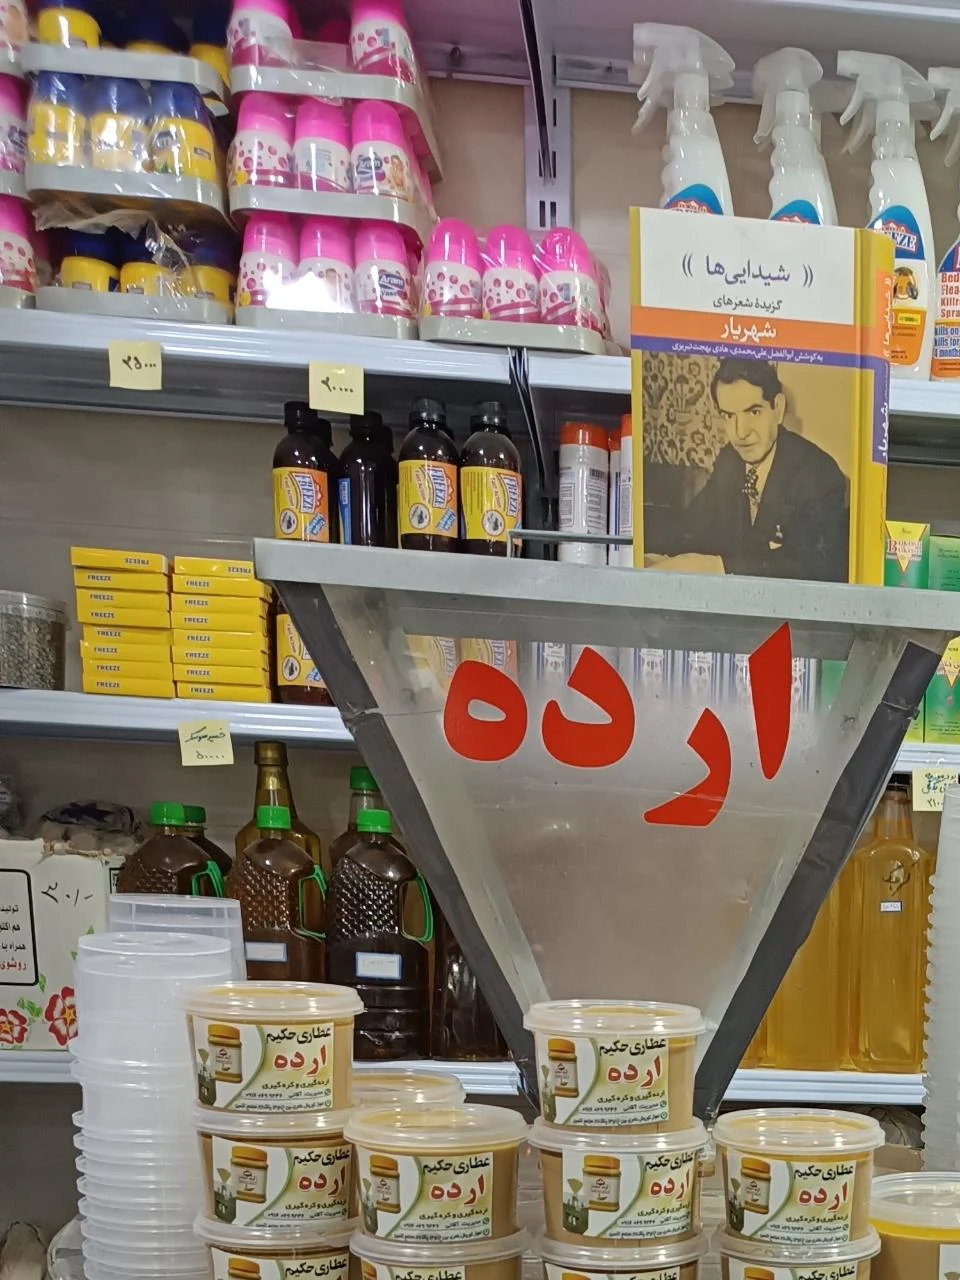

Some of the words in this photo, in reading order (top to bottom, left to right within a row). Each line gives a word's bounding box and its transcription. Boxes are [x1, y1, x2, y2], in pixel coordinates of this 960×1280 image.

[720, 316, 777, 343] شهریار
[443, 622, 792, 828] ارده
[266, 1027, 297, 1045] حکیم
[296, 1026, 331, 1044] عطاری
[599, 1039, 629, 1057] حکیم
[629, 1038, 666, 1056] عطاری
[273, 1045, 328, 1076] ارده
[607, 1055, 661, 1088] ارده
[422, 1160, 453, 1176] حکیم
[453, 1157, 490, 1175] عطاری
[793, 1165, 822, 1180] حکیم
[821, 1164, 853, 1181] عطاری
[430, 1174, 485, 1205] ارده
[798, 1181, 848, 1211] ارده
[285, 1262, 314, 1278] حکیم
[315, 1258, 347, 1276] عطاری
